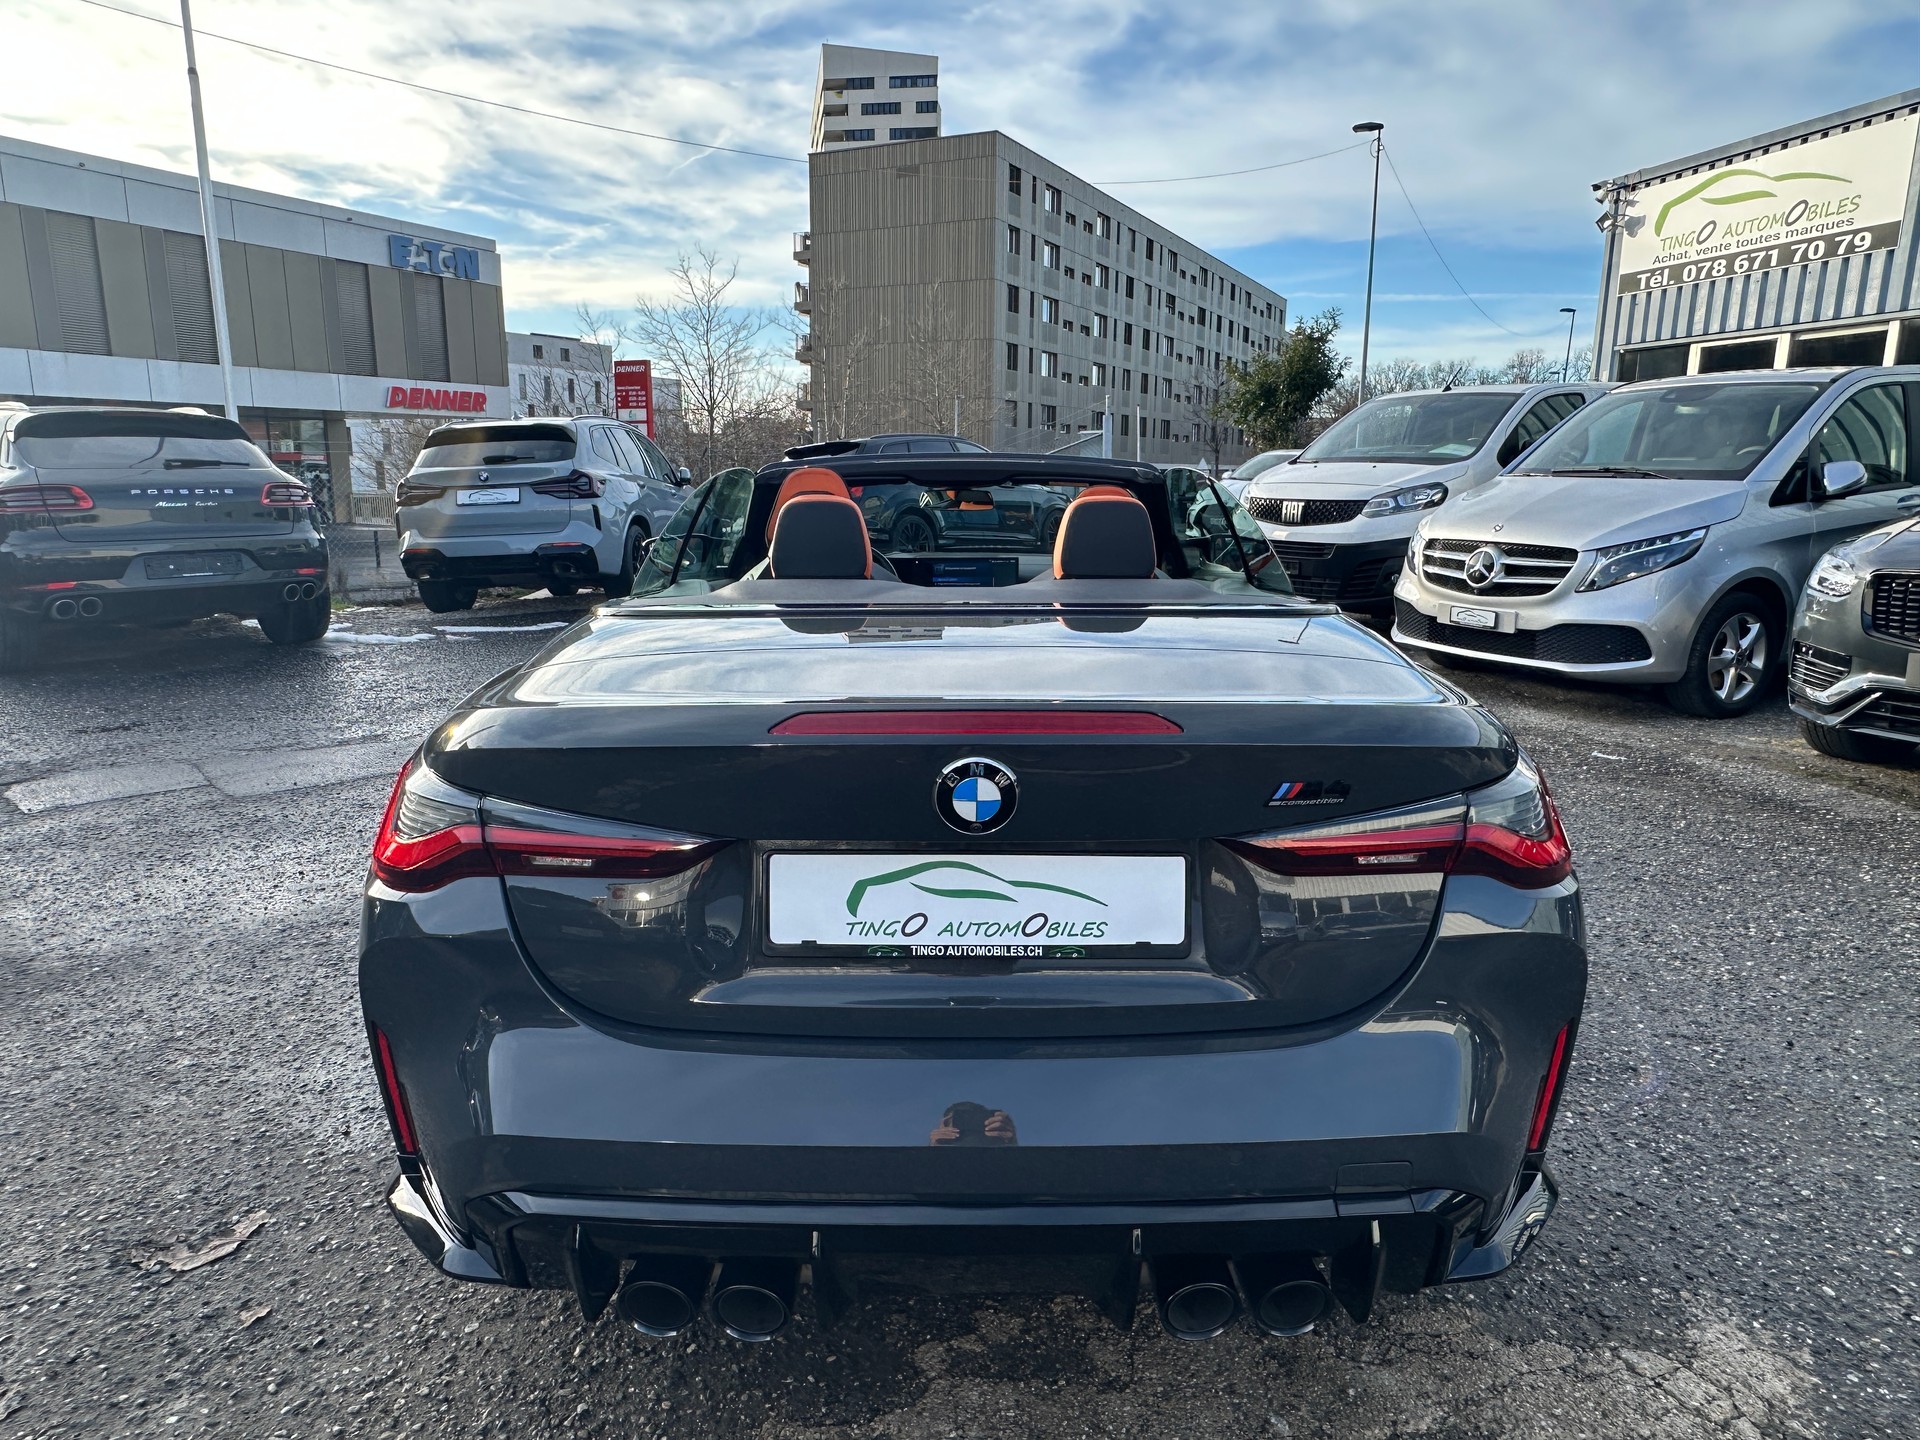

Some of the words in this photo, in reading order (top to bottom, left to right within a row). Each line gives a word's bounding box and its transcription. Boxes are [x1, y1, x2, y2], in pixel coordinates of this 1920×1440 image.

[1660, 220, 1717, 251] TINGO
[1722, 195, 1862, 239] AUTOMOBILES
[1652, 250, 1692, 265] Achat,
[1696, 242, 1732, 256] vente
[1736, 232, 1781, 248] toutes
[1785, 217, 1855, 238] marques
[389, 234, 480, 280] EATON
[1637, 268, 1675, 290] Tél.
[1682, 259, 1727, 282] 078
[1734, 248, 1779, 275] 671
[1790, 240, 1826, 263] 70
[1834, 231, 1873, 255] 79
[616, 365, 646, 373] DENNER
[386, 386, 488, 412] DENNER
[1281, 500, 1305, 523] FIAT
[944, 763, 1011, 788] BMW
[846, 912, 929, 938] TINGO
[937, 912, 1109, 938] AUTOMOBILES
[911, 945, 944, 956] TINGO
[946, 945, 1043, 956] AUTOMOBILES.CH
